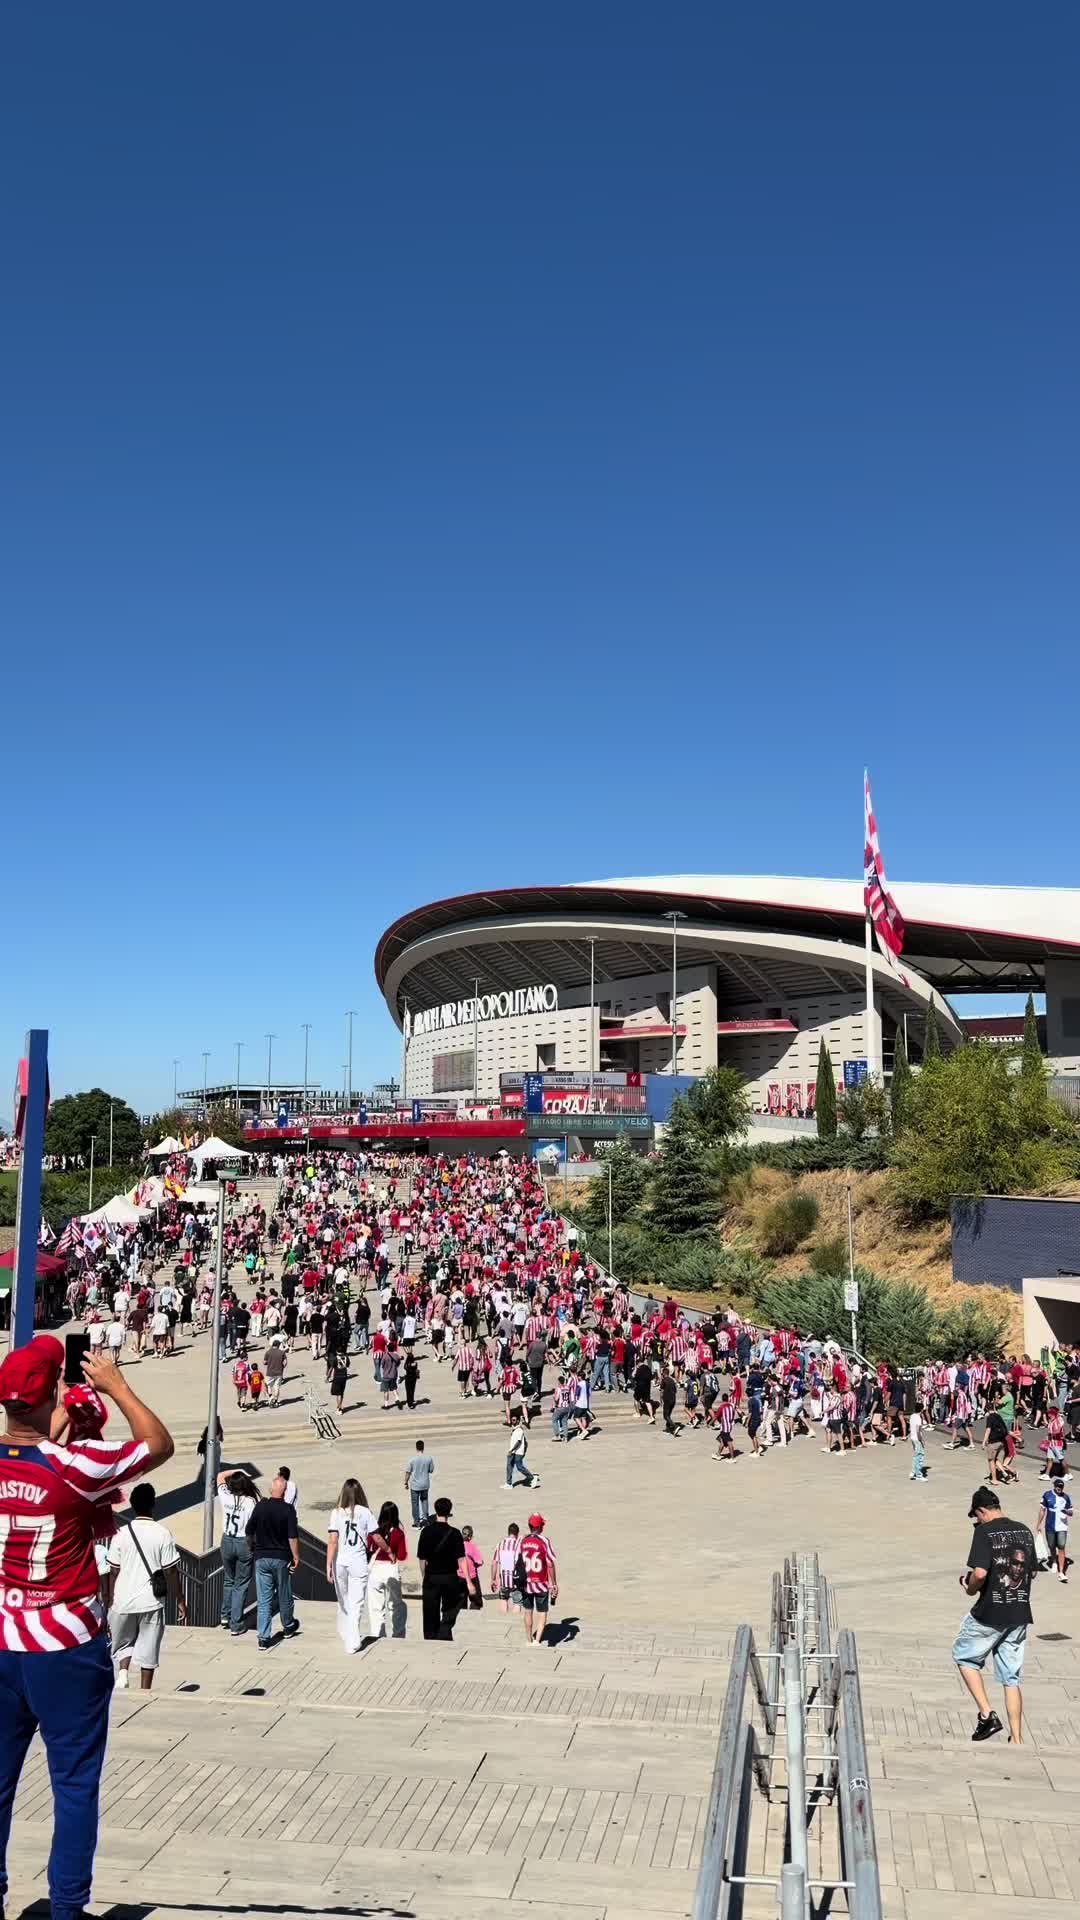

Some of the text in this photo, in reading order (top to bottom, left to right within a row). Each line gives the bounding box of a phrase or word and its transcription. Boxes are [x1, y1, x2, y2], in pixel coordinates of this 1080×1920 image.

[457, 984, 557, 1024] METROPOLITANO
[593, 1140, 615, 1148] ACCESO
[0, 1480, 49, 1505] ISTOV
[225, 1513, 240, 1537] 15
[344, 1520, 358, 1546] 15
[27, 1589, 56, 1599] Money
